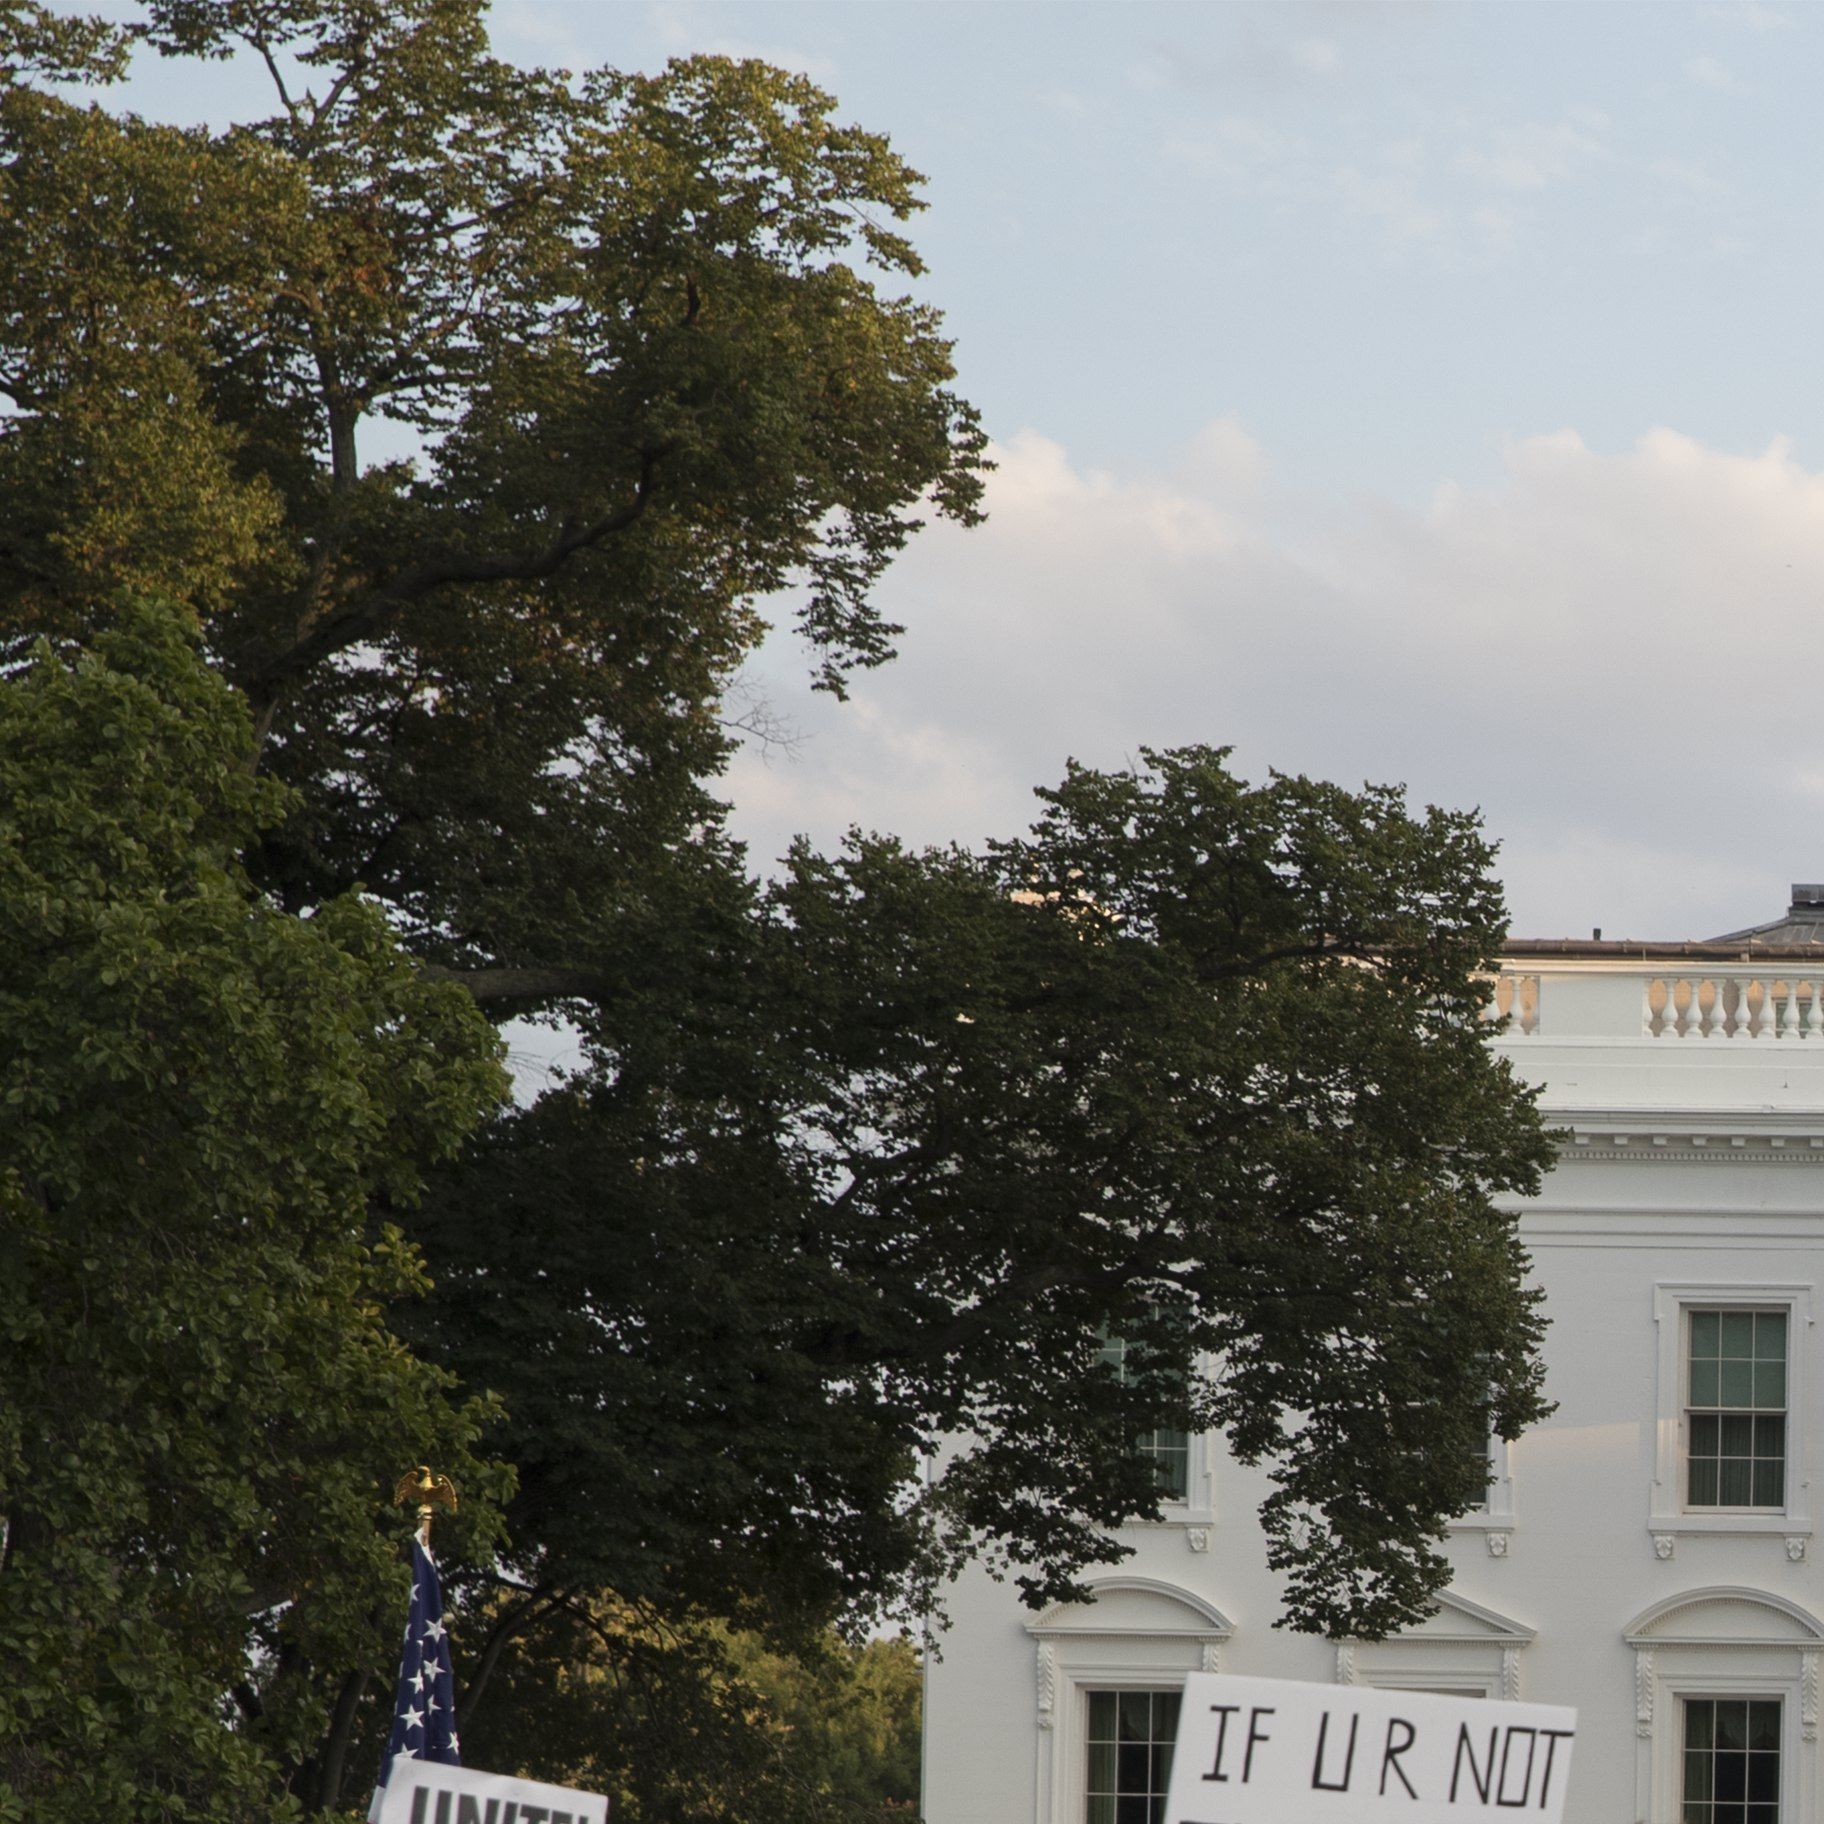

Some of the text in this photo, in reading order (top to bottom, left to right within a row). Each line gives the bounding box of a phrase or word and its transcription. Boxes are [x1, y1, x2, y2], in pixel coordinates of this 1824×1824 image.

[1202, 1704, 1575, 1810] IF U R NOT
